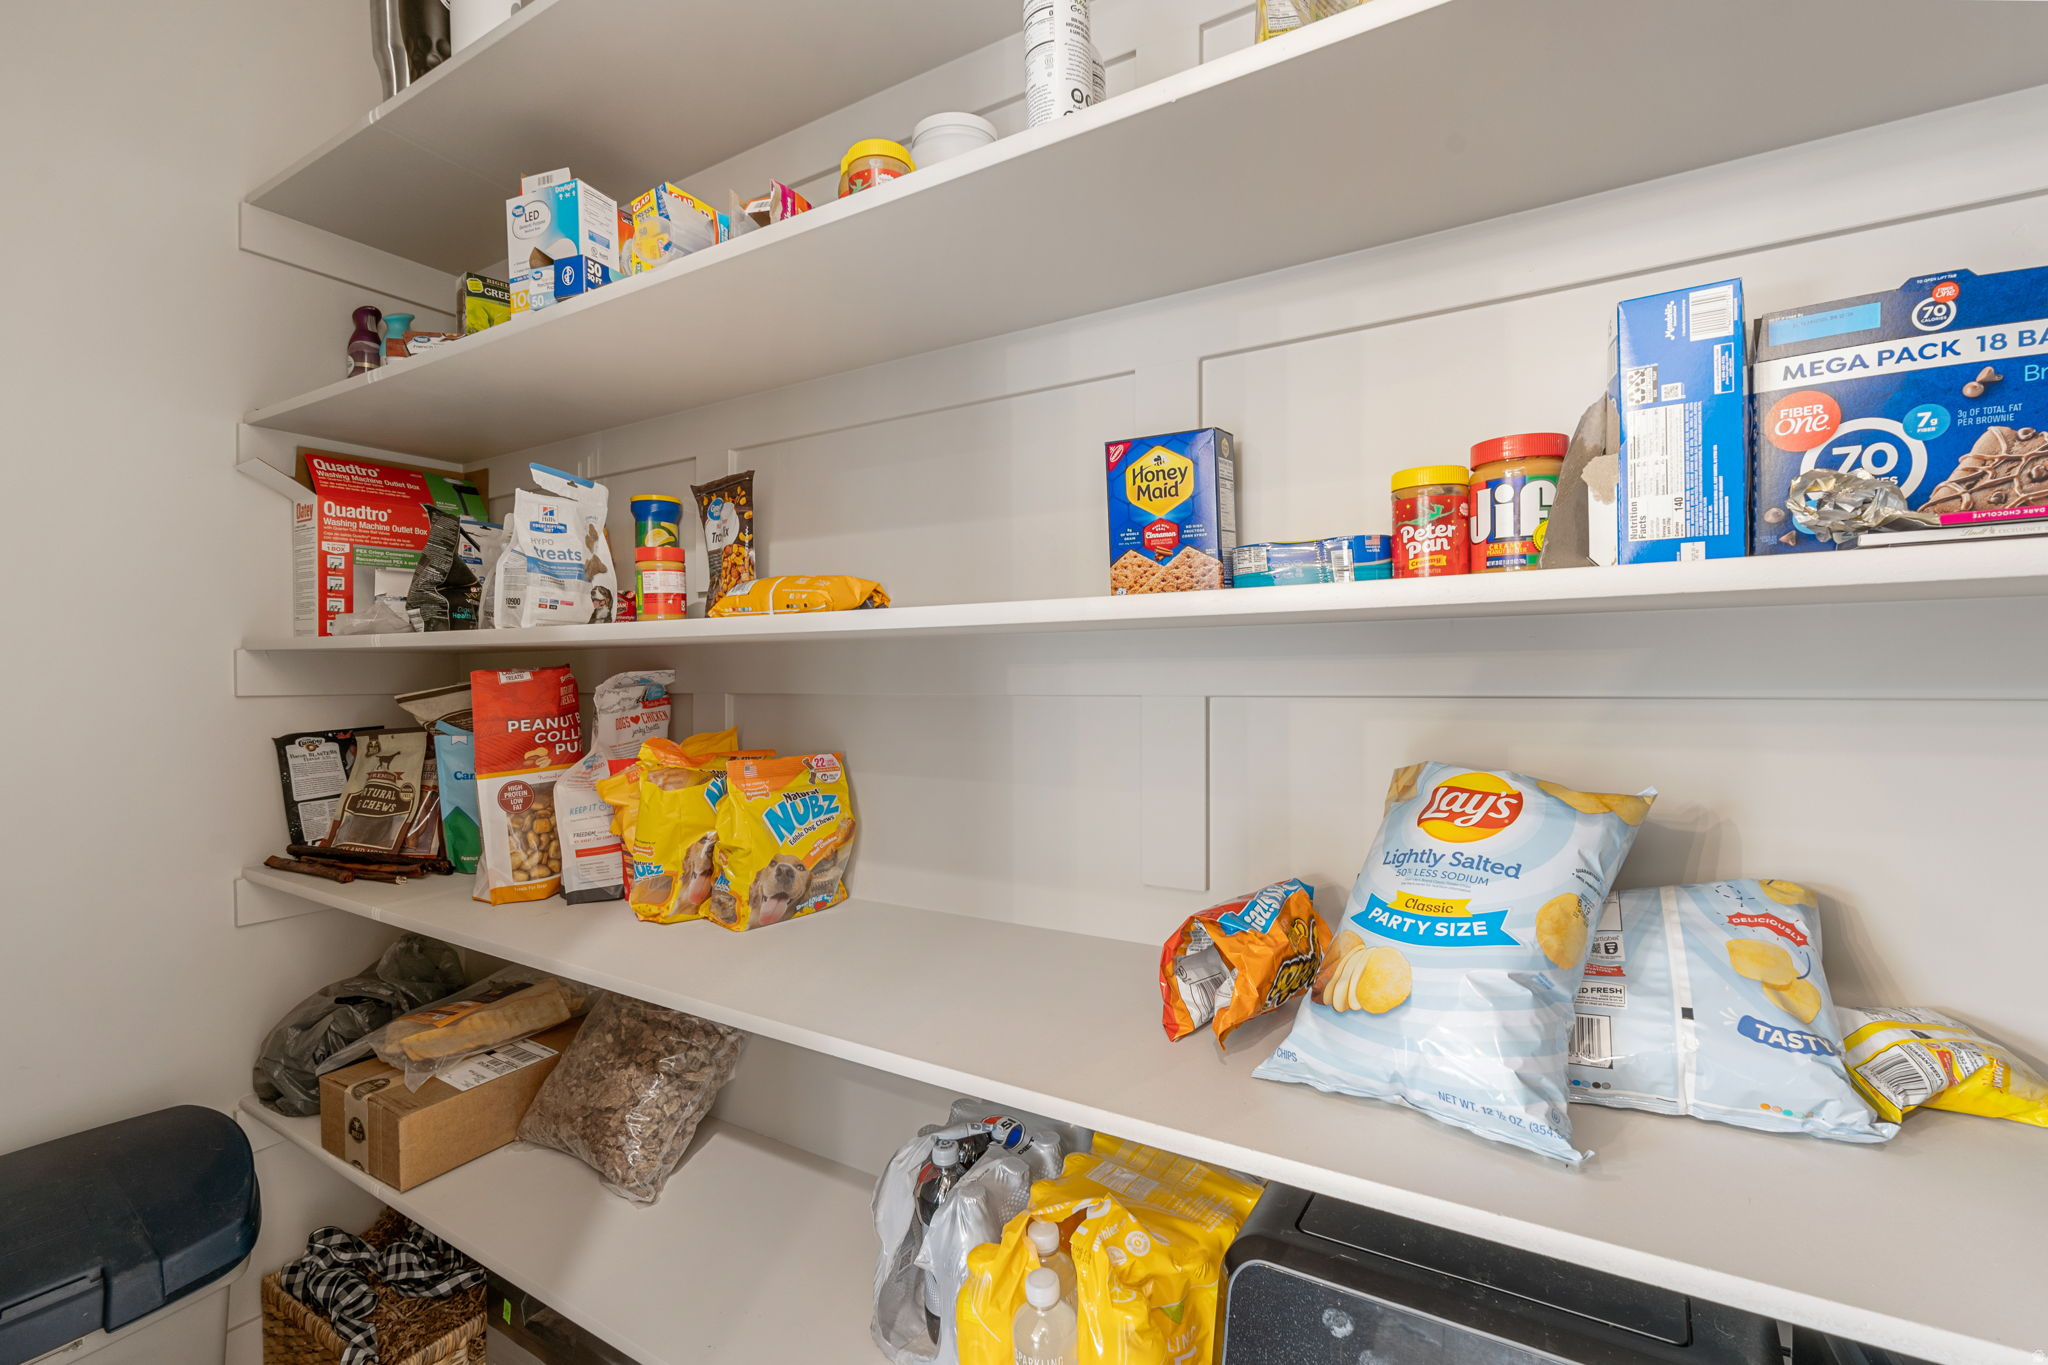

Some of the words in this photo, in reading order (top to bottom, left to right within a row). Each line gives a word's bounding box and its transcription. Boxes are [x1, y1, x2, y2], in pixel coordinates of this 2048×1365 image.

[633, 193, 650, 213] GLAD
[524, 210, 539, 222] LED
[587, 260, 602, 277] 50
[486, 278, 509, 288] BIGEL
[587, 274, 595, 284] SQ
[595, 277, 602, 285] FT
[484, 287, 511, 300] GREE
[512, 292, 530, 308] 10
[532, 295, 544, 307] 50
[1922, 304, 1947, 319] 70
[1782, 353, 1869, 382] MEGA
[1877, 339, 1961, 366] PACK
[1976, 332, 2008, 352] 18
[1780, 404, 1825, 419] FIBER
[1957, 409, 1968, 419] 3g
[1970, 407, 1981, 416] OF
[1983, 405, 2006, 415] TOTAL
[2008, 403, 2023, 413] FAT
[1916, 411, 1938, 430] 7g
[1957, 418, 1973, 427] PER
[1976, 414, 2015, 425] BROWNIE
[313, 459, 378, 477] Quadtro
[1831, 442, 1899, 476] 70
[316, 470, 350, 481] Washing
[351, 475, 382, 485] Machine
[384, 480, 406, 489] Outlet
[1132, 464, 1188, 486] Honey
[1136, 481, 1180, 502] Maid
[323, 501, 388, 522] Quadtro
[1470, 480, 1556, 544] Jif
[1674, 496, 1683, 513] 140
[1630, 501, 1638, 540] Nutrition
[1972, 510, 2021, 519] CHOCOLATE
[323, 517, 357, 528] Washing
[359, 521, 390, 532] Machine
[392, 525, 413, 534] Outlet
[414, 527, 428, 536] Box
[1146, 531, 1176, 539] Cinnamon
[1400, 522, 1456, 544] Peter
[1638, 515, 1647, 540] Facts
[530, 537, 554, 545] HYPO
[1406, 538, 1450, 559] Pan
[533, 546, 582, 561] treats
[507, 714, 574, 733] PEANUT
[616, 716, 631, 730] DOGS
[640, 710, 670, 724] CHICKEN
[814, 757, 826, 768] 22
[504, 789, 528, 799] PROTEIN
[782, 788, 820, 803] Natural
[361, 800, 397, 812] CHEWS
[570, 806, 588, 816] KEEP
[1420, 786, 1519, 828] Lay's
[762, 794, 840, 847] NUBZ
[789, 831, 805, 846] Edible
[803, 824, 817, 834] Dog
[815, 815, 835, 827] Chews
[1382, 848, 1446, 868] Lightly
[1448, 851, 1523, 880] Salted
[1395, 868, 1412, 877] 50%
[1413, 868, 1438, 878] LESS
[1440, 870, 1489, 886] SODIUM
[1404, 898, 1454, 914] Classic
[1367, 907, 1431, 935] PARTY
[1434, 920, 1488, 937] SIZE
[1731, 917, 1804, 943] DELICIOUSLY
[1590, 987, 1622, 995] FRESH
[1755, 1023, 1833, 1053] TASTY
[1276, 1047, 1298, 1062] CHIPS
[1906, 1043, 1942, 1081] GUARANTEED
[1438, 1091, 1457, 1105] NET
[1458, 1098, 1478, 1113] WT.
[1481, 1105, 1495, 1116] 12
[1508, 1115, 1526, 1129] OZ.
[1017, 1136, 1034, 1155] DIET
